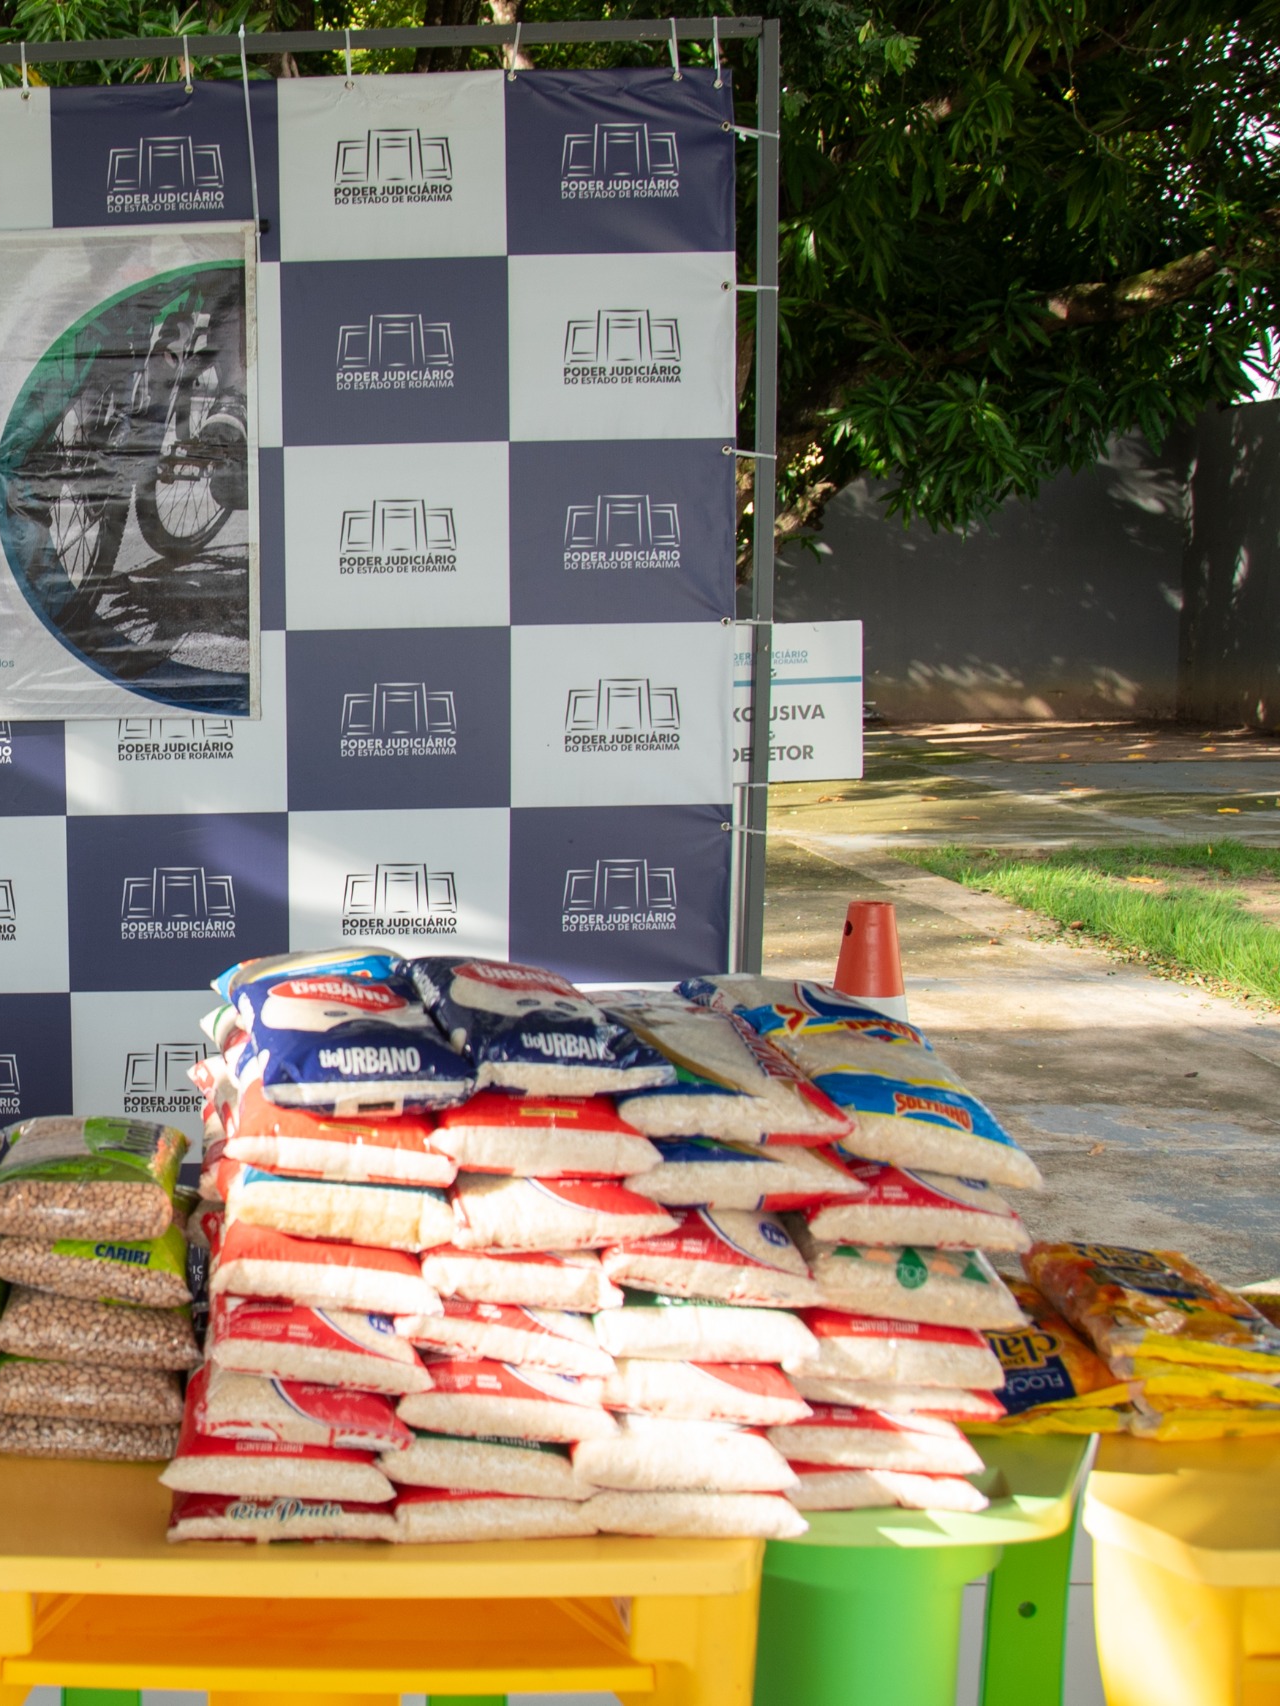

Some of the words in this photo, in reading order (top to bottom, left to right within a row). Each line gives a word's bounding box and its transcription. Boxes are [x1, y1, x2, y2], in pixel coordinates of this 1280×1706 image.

[561, 180, 604, 191] PODER
[607, 177, 679, 190] JUDICIÁRIO
[561, 191, 576, 199] DO
[578, 191, 616, 199] ESTADO
[618, 190, 631, 198] DE
[634, 190, 679, 198] RORAIMA
[336, 371, 379, 382] PODER
[382, 367, 454, 381] JUDICIÁRIO
[337, 383, 351, 391] DO
[354, 382, 391, 390] ESTADO
[393, 381, 406, 389] DE
[409, 380, 454, 389] RORAIMA
[339, 556, 382, 567] PODER
[385, 552, 457, 566] JUDICIÁRIO
[340, 567, 354, 575] DO
[357, 566, 394, 574] ESTADO
[411, 565, 457, 573] RORAIMA
[564, 734, 607, 745] PODER
[609, 731, 680, 744] JUDICIÁRIO
[118, 743, 160, 753] PODER
[162, 739, 234, 753] JUDICIÁRIO
[565, 745, 579, 753] DO
[581, 744, 618, 752] ESTADO
[620, 744, 633, 752] DE
[635, 743, 680, 751] RORAIMA
[135, 753, 172, 761] ESTADO
[189, 752, 234, 760] RORAIMA
[562, 914, 604, 924] PODER
[606, 910, 677, 924] JUDICIÁRIO
[562, 924, 577, 932] DO
[579, 924, 615, 932] ESTADO
[617, 923, 629, 931] DE
[632, 923, 676, 931] RORAIMA
[94, 1243, 151, 1265] CARIRI
